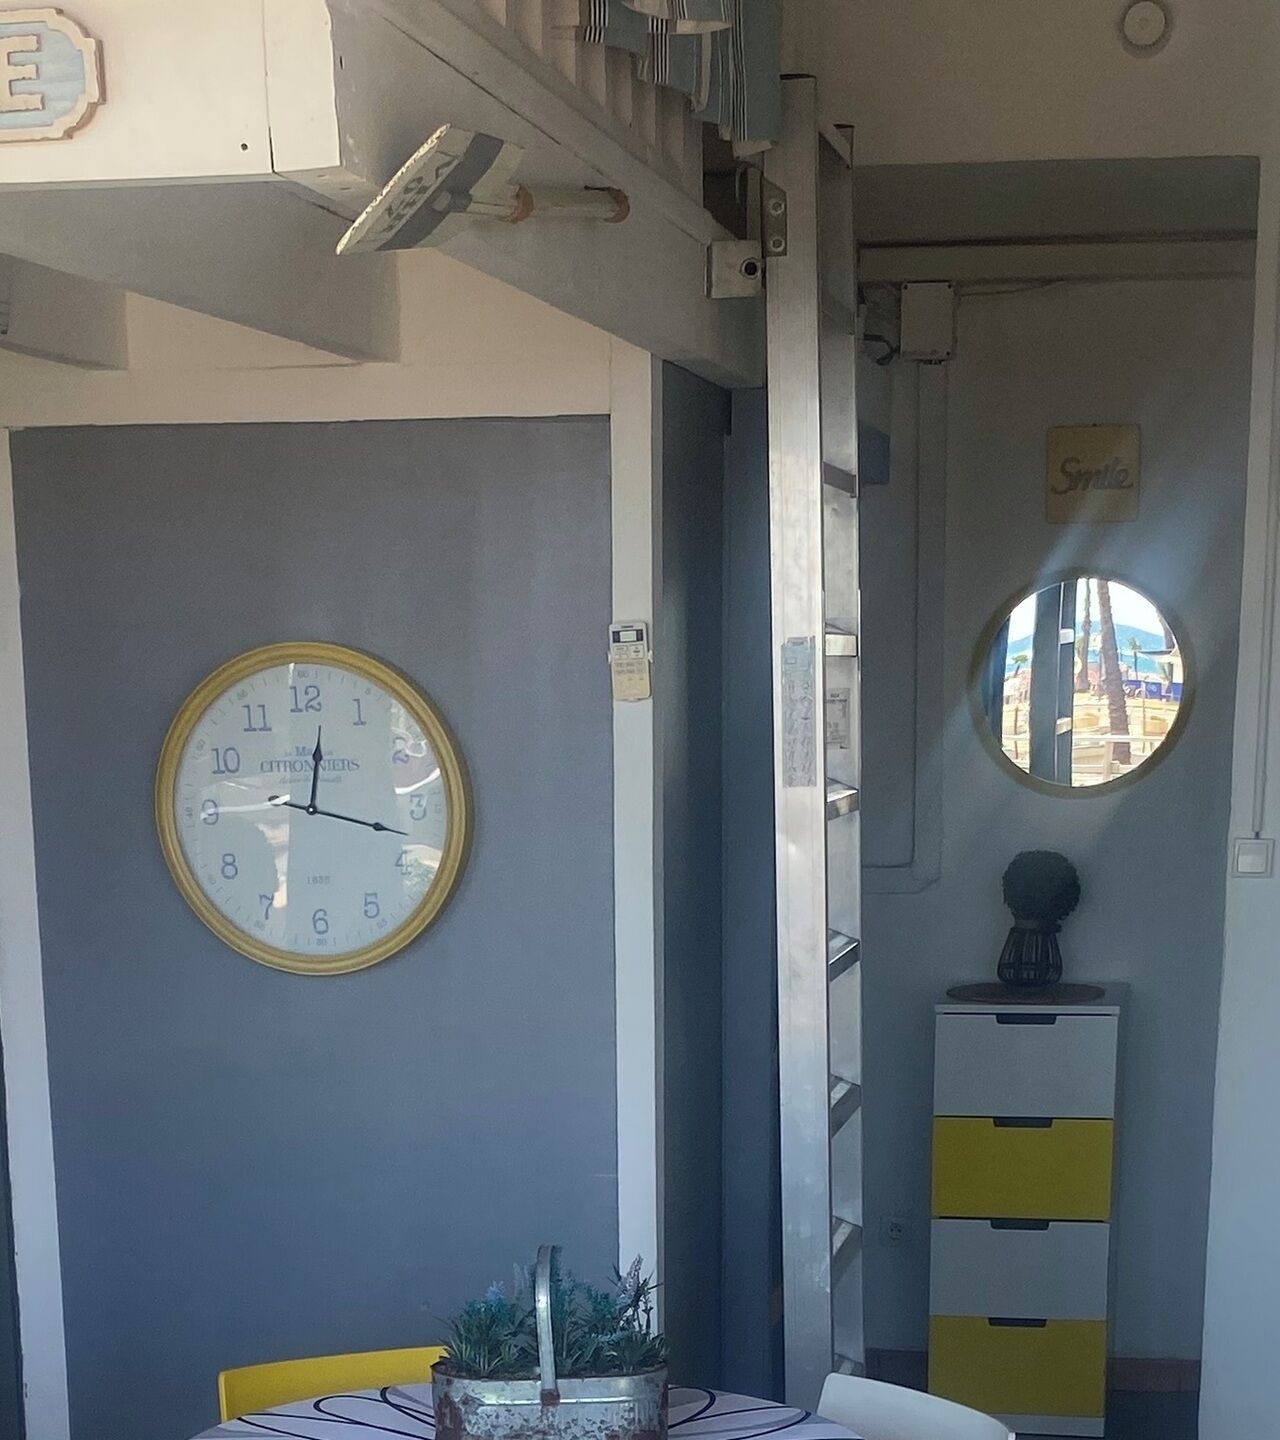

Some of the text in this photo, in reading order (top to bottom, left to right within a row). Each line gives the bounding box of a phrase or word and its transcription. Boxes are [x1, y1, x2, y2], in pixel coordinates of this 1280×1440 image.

[1050, 457, 1134, 495] Smile
[289, 685, 322, 713] 12
[352, 698, 367, 726] 1
[241, 704, 272, 732] 11
[211, 747, 241, 775] 10
[393, 736, 410, 764] 2
[260, 759, 360, 774] CITRONNIERS
[201, 799, 219, 826] 9
[409, 794, 427, 821] 3
[221, 853, 238, 880] 8
[394, 849, 413, 876] 4
[258, 894, 275, 921] 7
[363, 892, 380, 919] 5
[311, 908, 329, 935] 6
